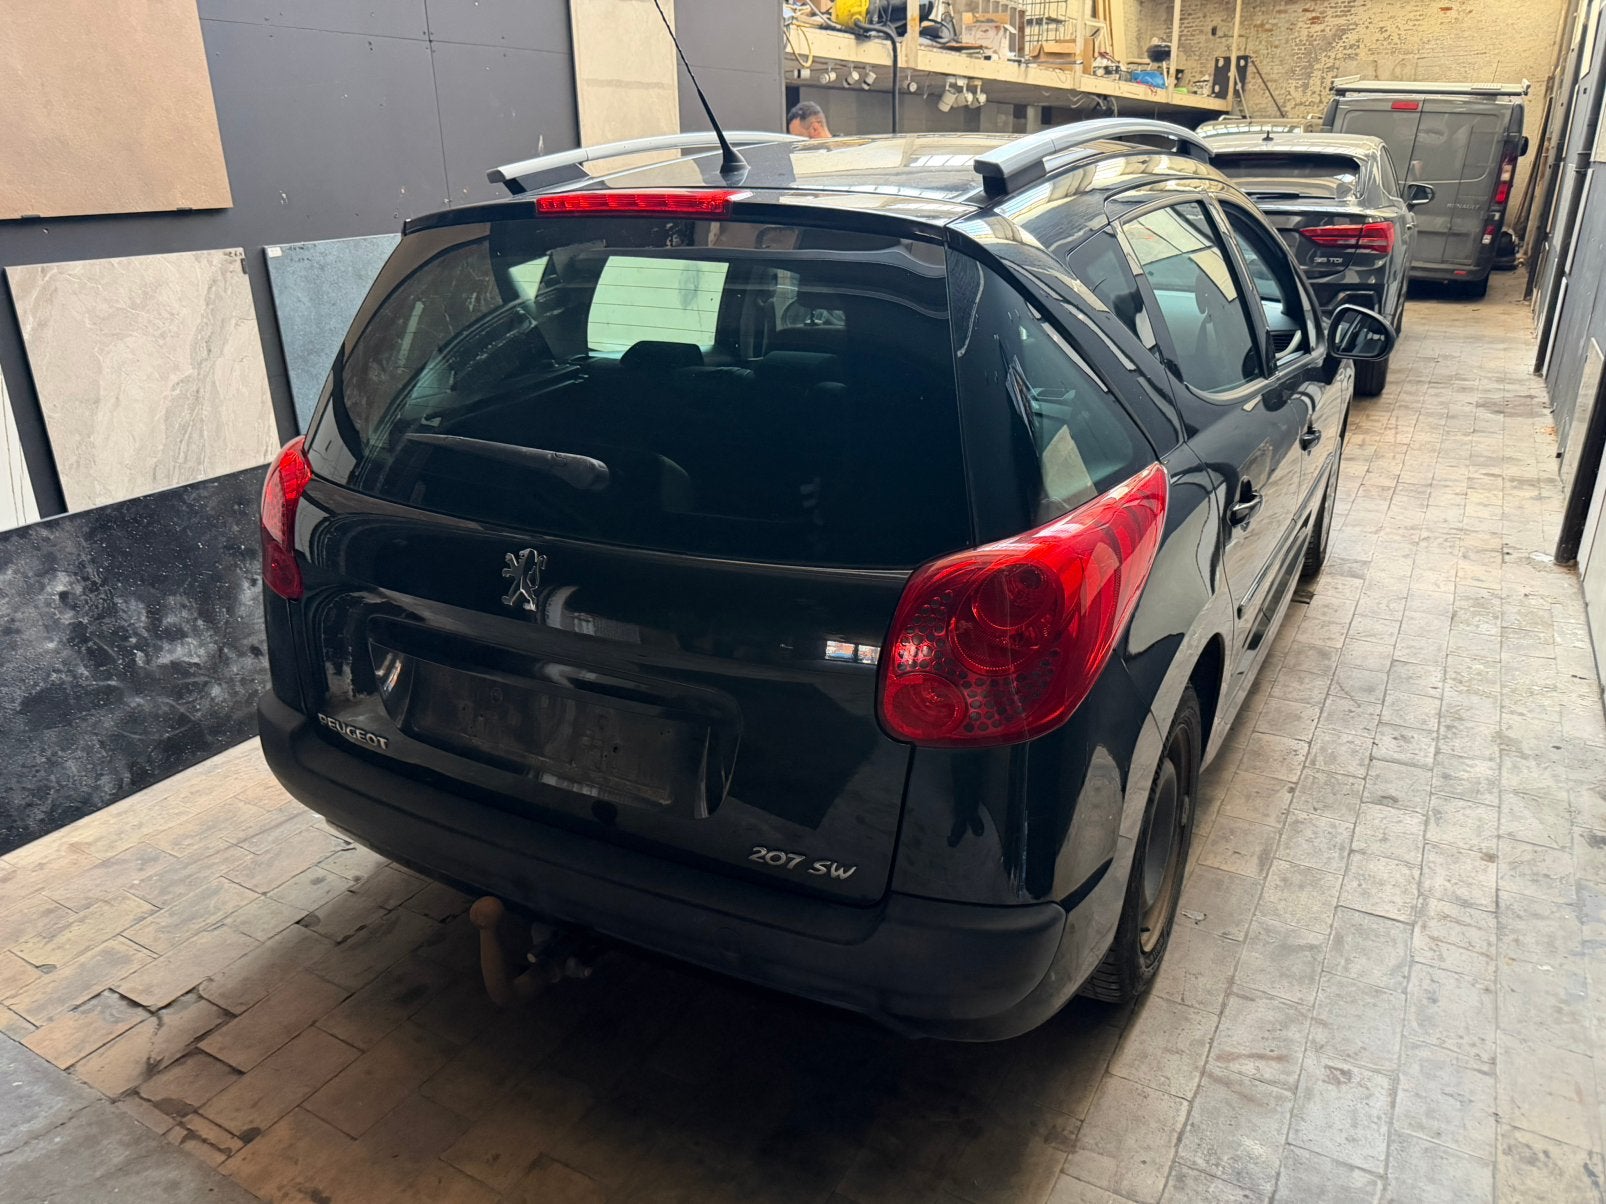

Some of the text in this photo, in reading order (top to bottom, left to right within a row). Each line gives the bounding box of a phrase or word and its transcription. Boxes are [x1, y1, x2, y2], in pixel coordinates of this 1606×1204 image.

[317, 712, 389, 750] PEUGEOT
[747, 846, 857, 880] 207 SW
